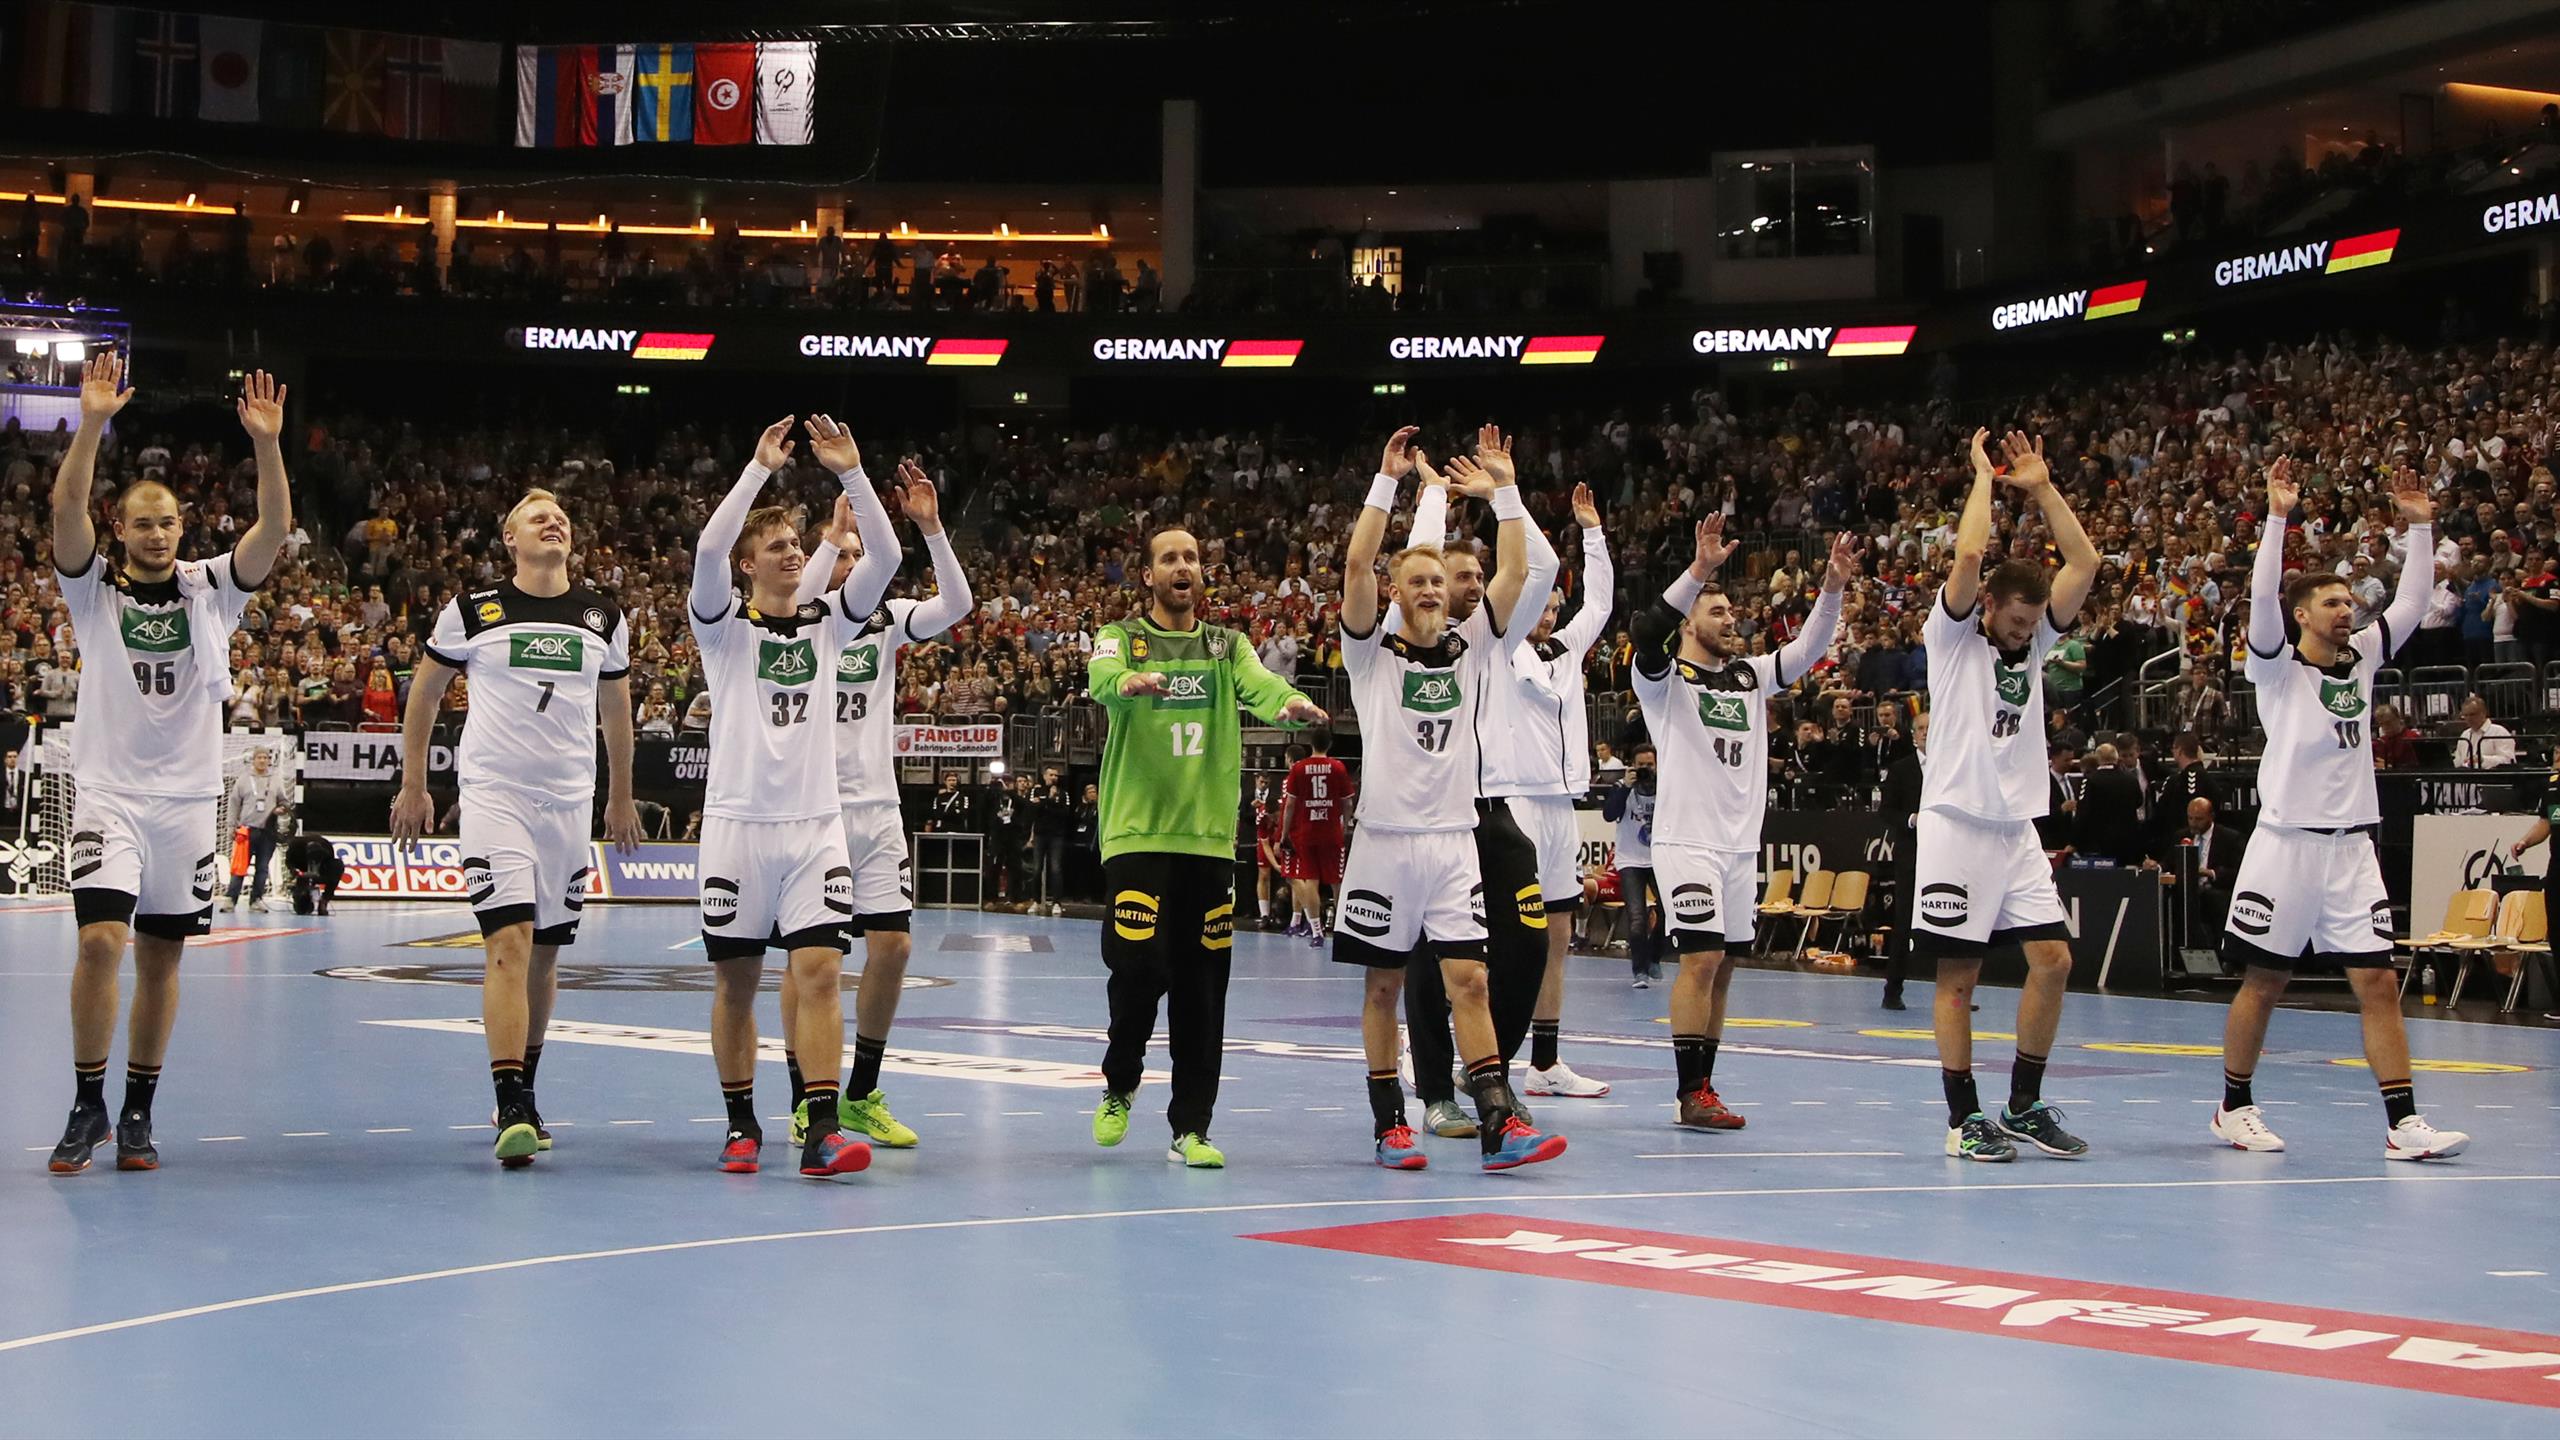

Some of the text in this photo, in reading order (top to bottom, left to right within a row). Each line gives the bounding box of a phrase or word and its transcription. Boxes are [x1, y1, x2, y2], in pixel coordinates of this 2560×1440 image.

[2215, 241, 2328, 287] GERMANY
[1992, 290, 2087, 331] GERMANY
[525, 327, 636, 352] ERMANY
[800, 335, 931, 358] GERMANY
[1094, 338, 1225, 361] GERMANY
[1390, 336, 1523, 360] GERMANY
[1693, 328, 1831, 354] GERMANY
[131, 617, 178, 639] AOK
[523, 637, 572, 657] AOK
[769, 646, 805, 670] AOK
[133, 661, 175, 696] 95
[1169, 675, 1206, 695] AOK
[1413, 678, 1452, 698] AOK
[536, 681, 555, 713] 7
[836, 692, 867, 723] 23
[772, 692, 809, 727] 32
[914, 728, 998, 742] FANCLUB
[1170, 722, 1204, 757] 12
[1418, 720, 1453, 752] 37
[2335, 721, 2361, 749] 10
[668, 748, 711, 763] STAN
[1311, 775, 1328, 799] 15
[334, 843, 393, 866] QUI
[408, 844, 462, 867] LIQ
[337, 868, 395, 890] OLY
[824, 884, 852, 896] HART
[703, 897, 738, 908] ARTING
[1345, 903, 1392, 923] HARTING
[1673, 899, 1715, 910] HARTING
[1921, 900, 1968, 911] HARTING
[2234, 905, 2273, 923] HARTING
[1115, 908, 1158, 924] HARTING
